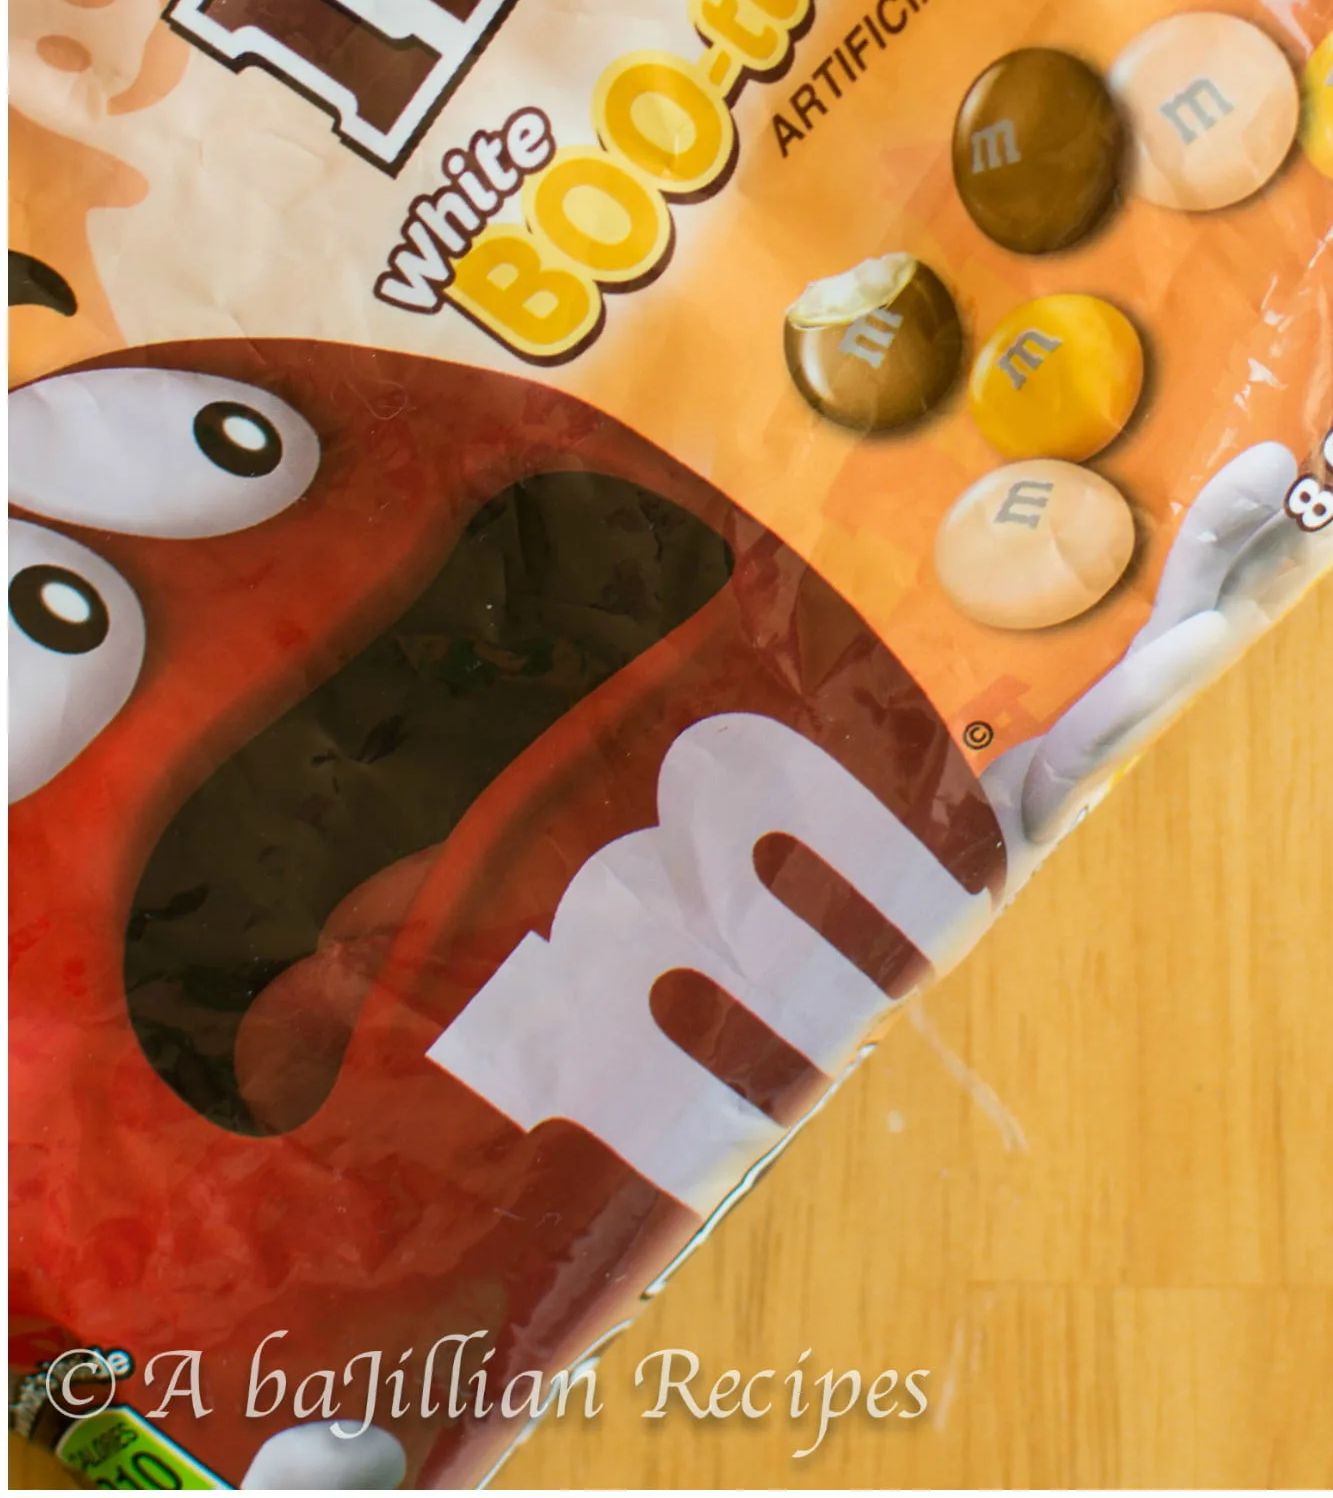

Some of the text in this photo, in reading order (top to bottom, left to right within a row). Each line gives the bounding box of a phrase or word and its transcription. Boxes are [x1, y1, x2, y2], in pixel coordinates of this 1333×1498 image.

[1159, 77, 1235, 145] m
[970, 117, 1021, 174] m
[996, 327, 1063, 391] m
[993, 476, 1054, 529] m
[425, 711, 997, 1222] m
